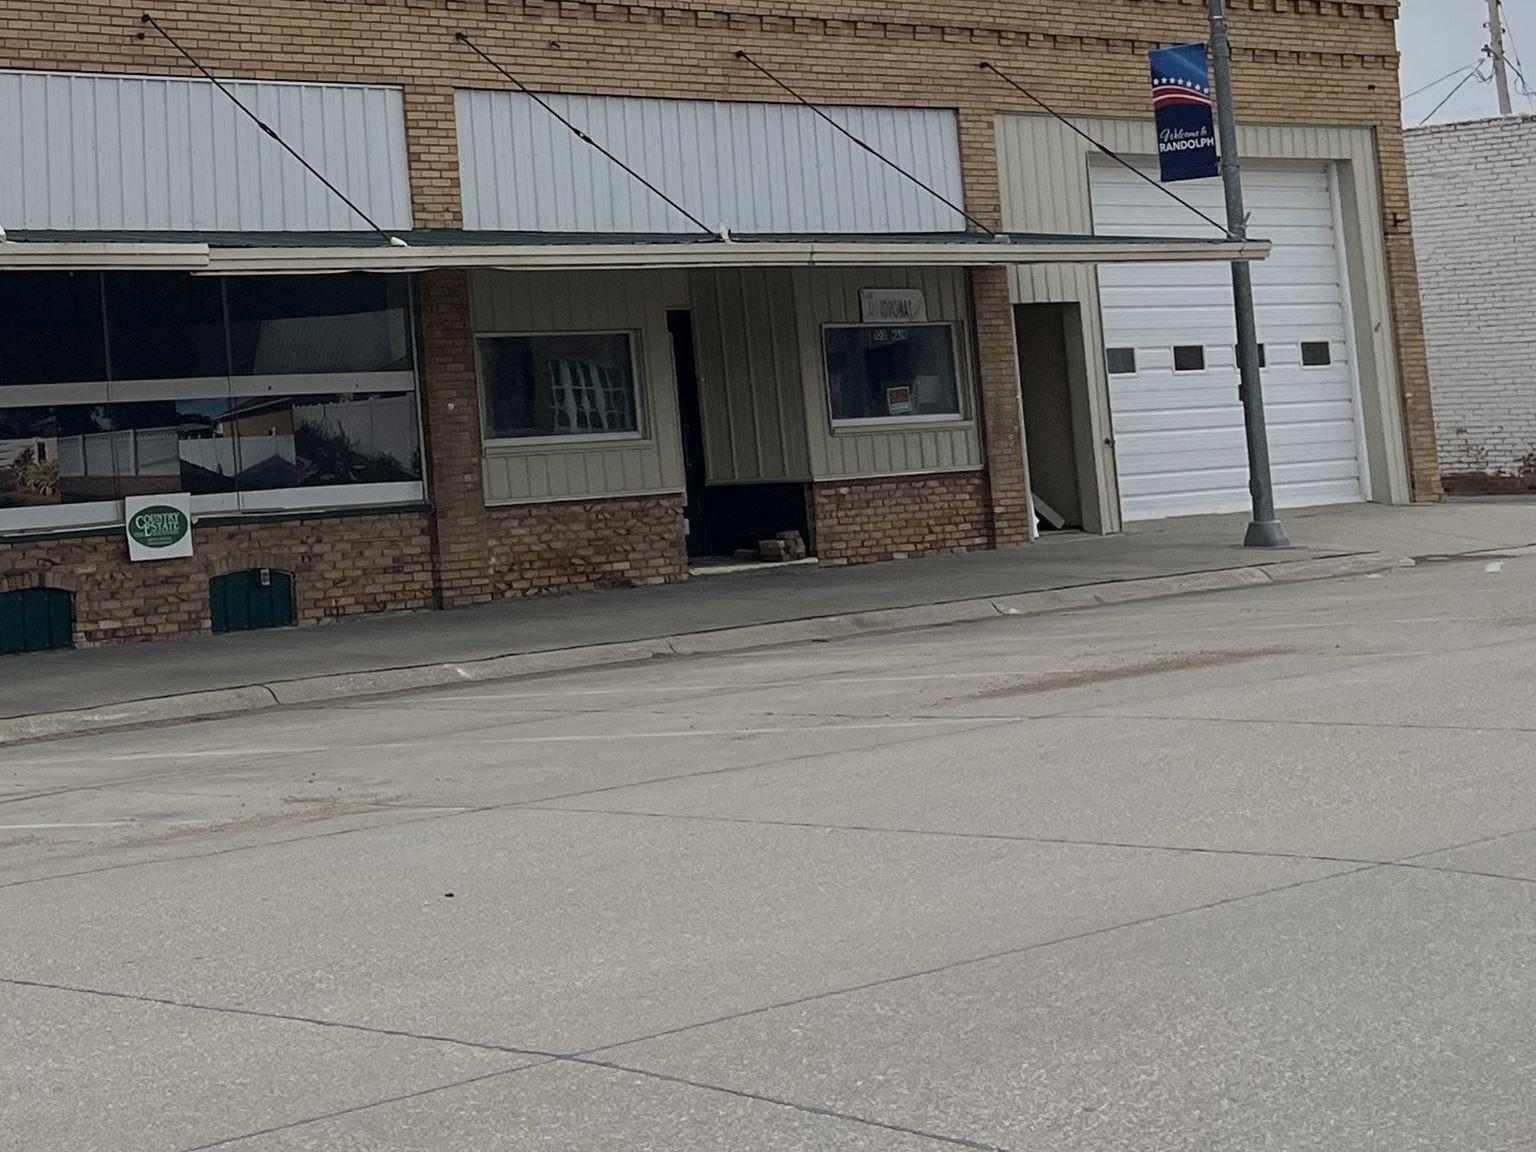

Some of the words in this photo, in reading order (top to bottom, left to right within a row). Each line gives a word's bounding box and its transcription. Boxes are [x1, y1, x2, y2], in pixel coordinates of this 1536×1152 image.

[1159, 128, 1199, 142] Welcome
[1159, 137, 1214, 152] RANDOLPH
[135, 512, 179, 529] COUNTRY
[143, 521, 179, 537] ESTATE
